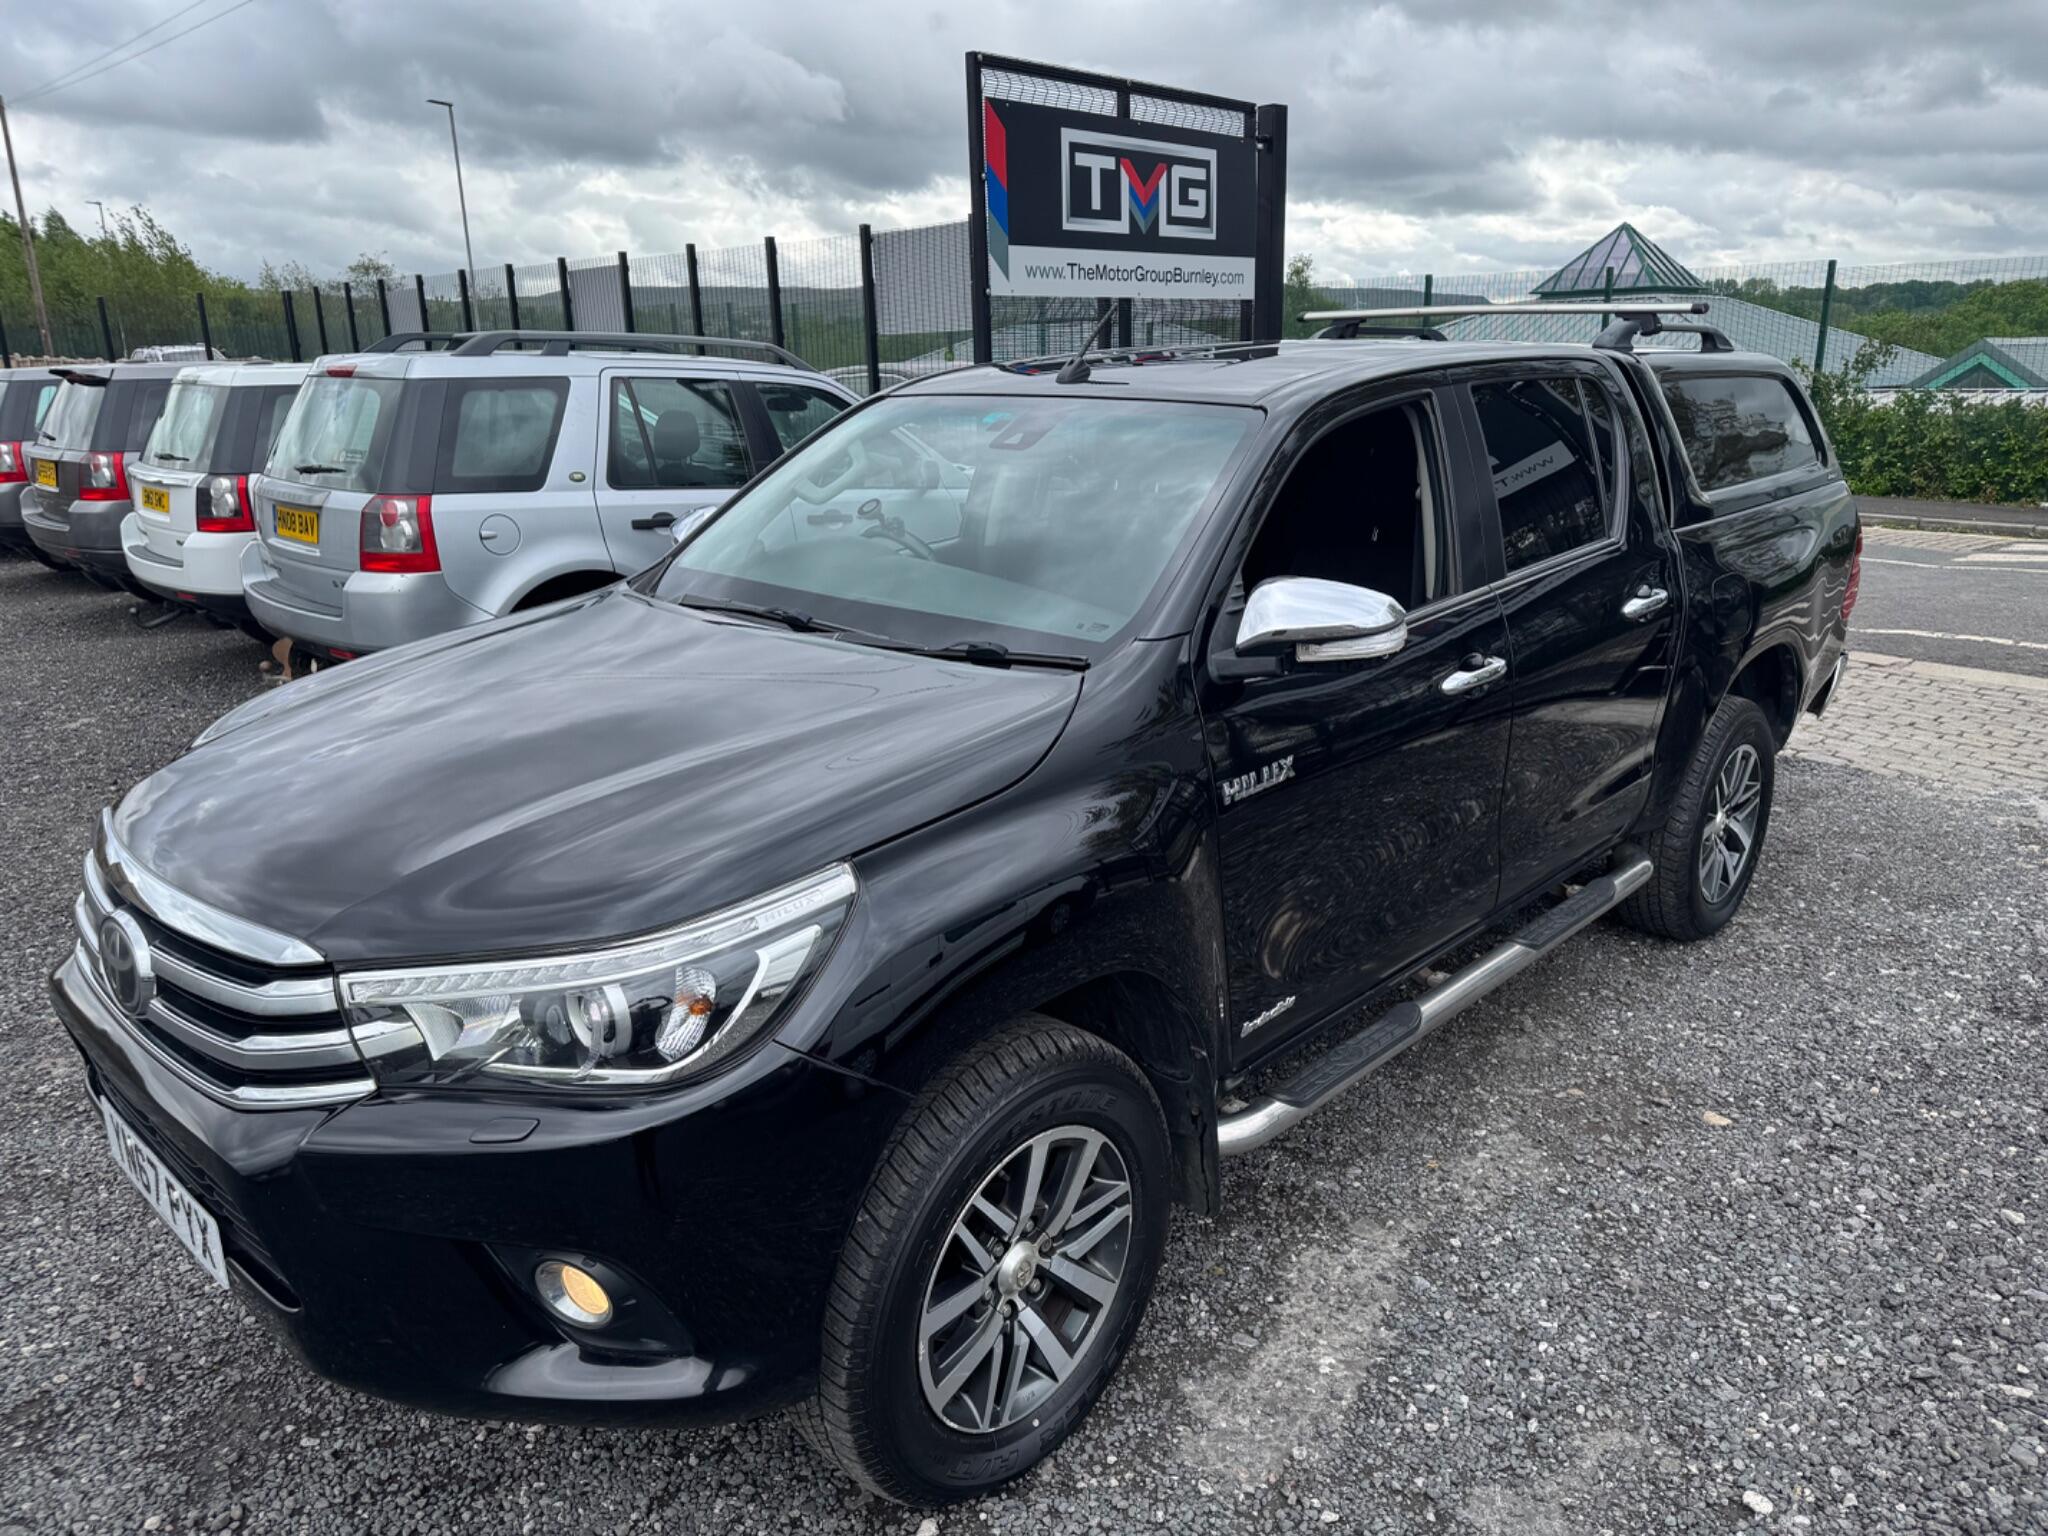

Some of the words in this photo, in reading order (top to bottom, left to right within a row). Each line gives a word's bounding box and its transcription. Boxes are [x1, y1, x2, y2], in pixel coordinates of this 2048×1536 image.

[1074, 152, 1207, 234] TMG
[1024, 262, 1244, 286] www.TheMotorGroupBurnley.com
[1221, 754, 1296, 806] HILUX
